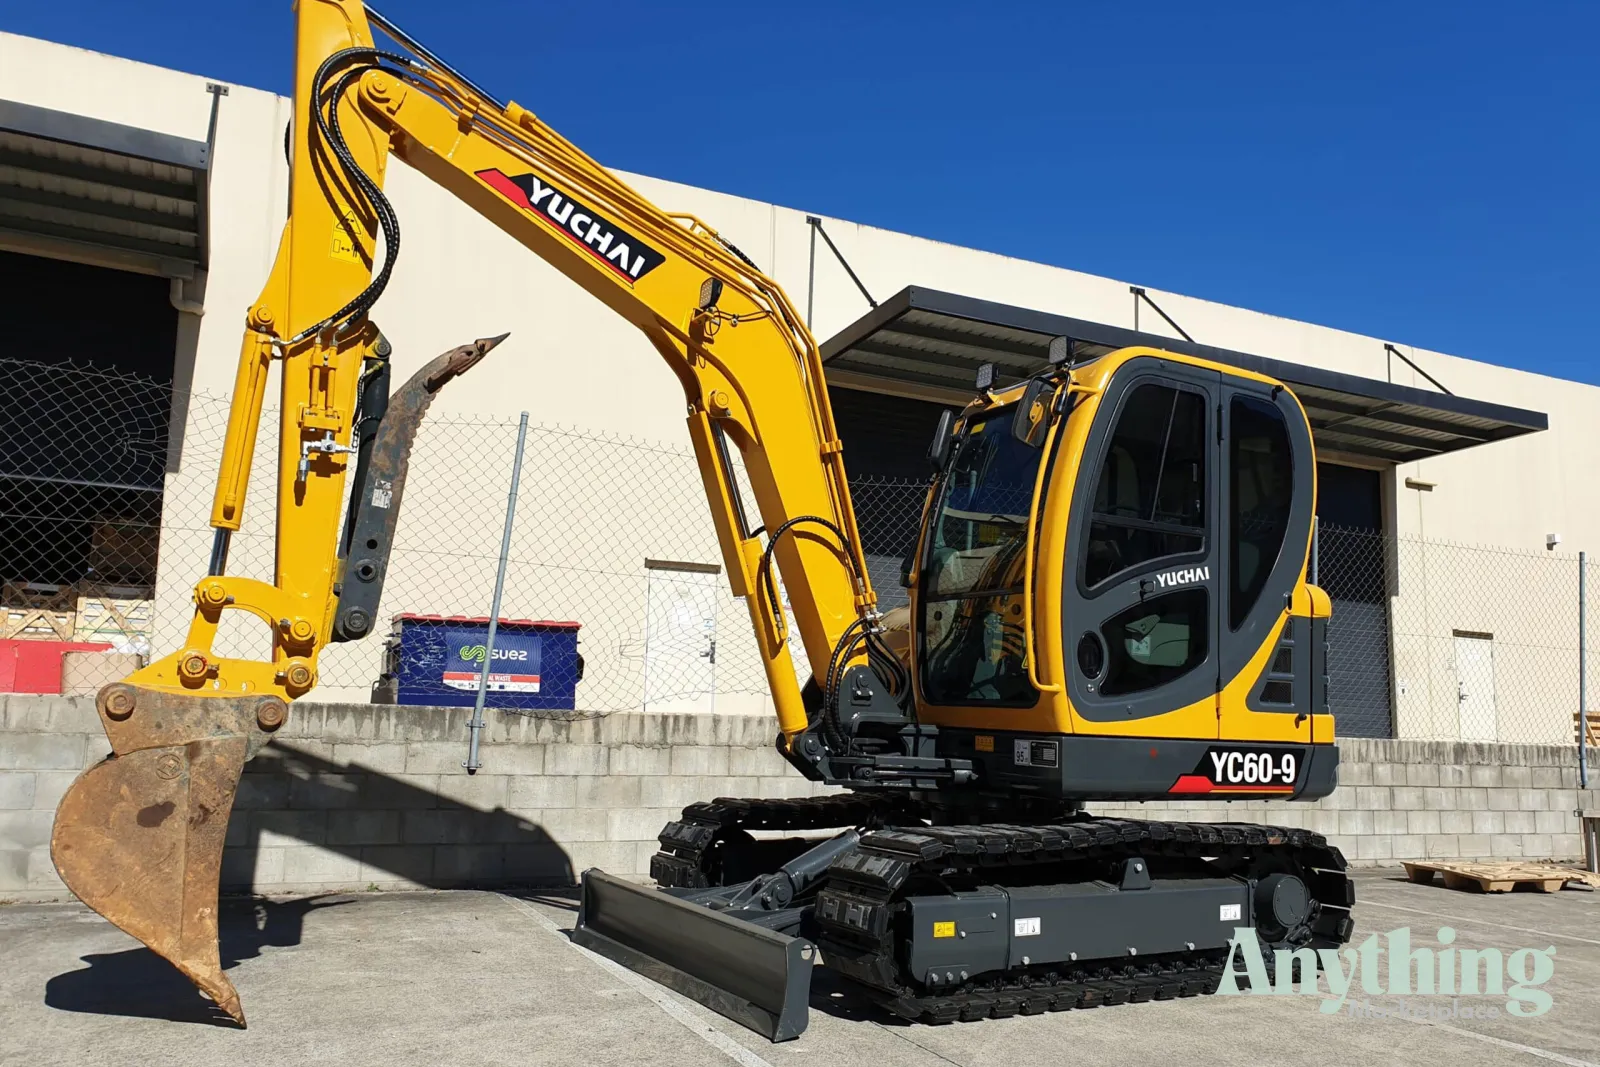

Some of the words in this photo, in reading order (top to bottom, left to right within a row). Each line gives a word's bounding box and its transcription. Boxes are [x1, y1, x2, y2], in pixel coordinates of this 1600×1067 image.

[530, 176, 646, 278] YUCHAI
[1156, 566, 1210, 587] YUCHAI
[1210, 752, 1296, 784] YC60-9
